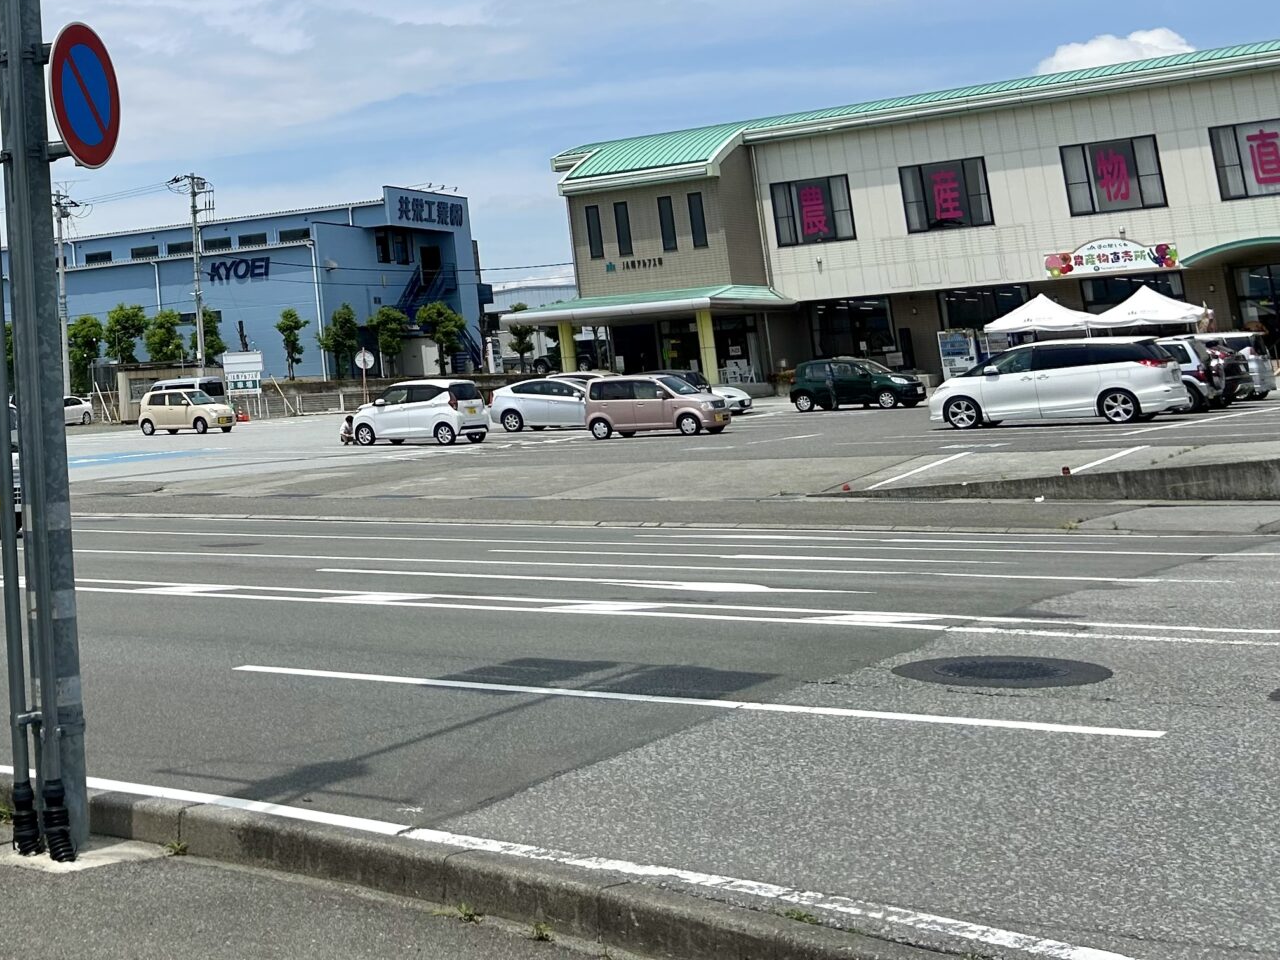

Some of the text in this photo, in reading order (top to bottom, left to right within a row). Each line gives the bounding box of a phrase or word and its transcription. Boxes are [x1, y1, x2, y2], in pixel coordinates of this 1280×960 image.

[800, 129, 1280, 236] 農 産 物 直
[210, 257, 270, 282] KYOEI
[1073, 249, 1147, 267] 農産物直売所
